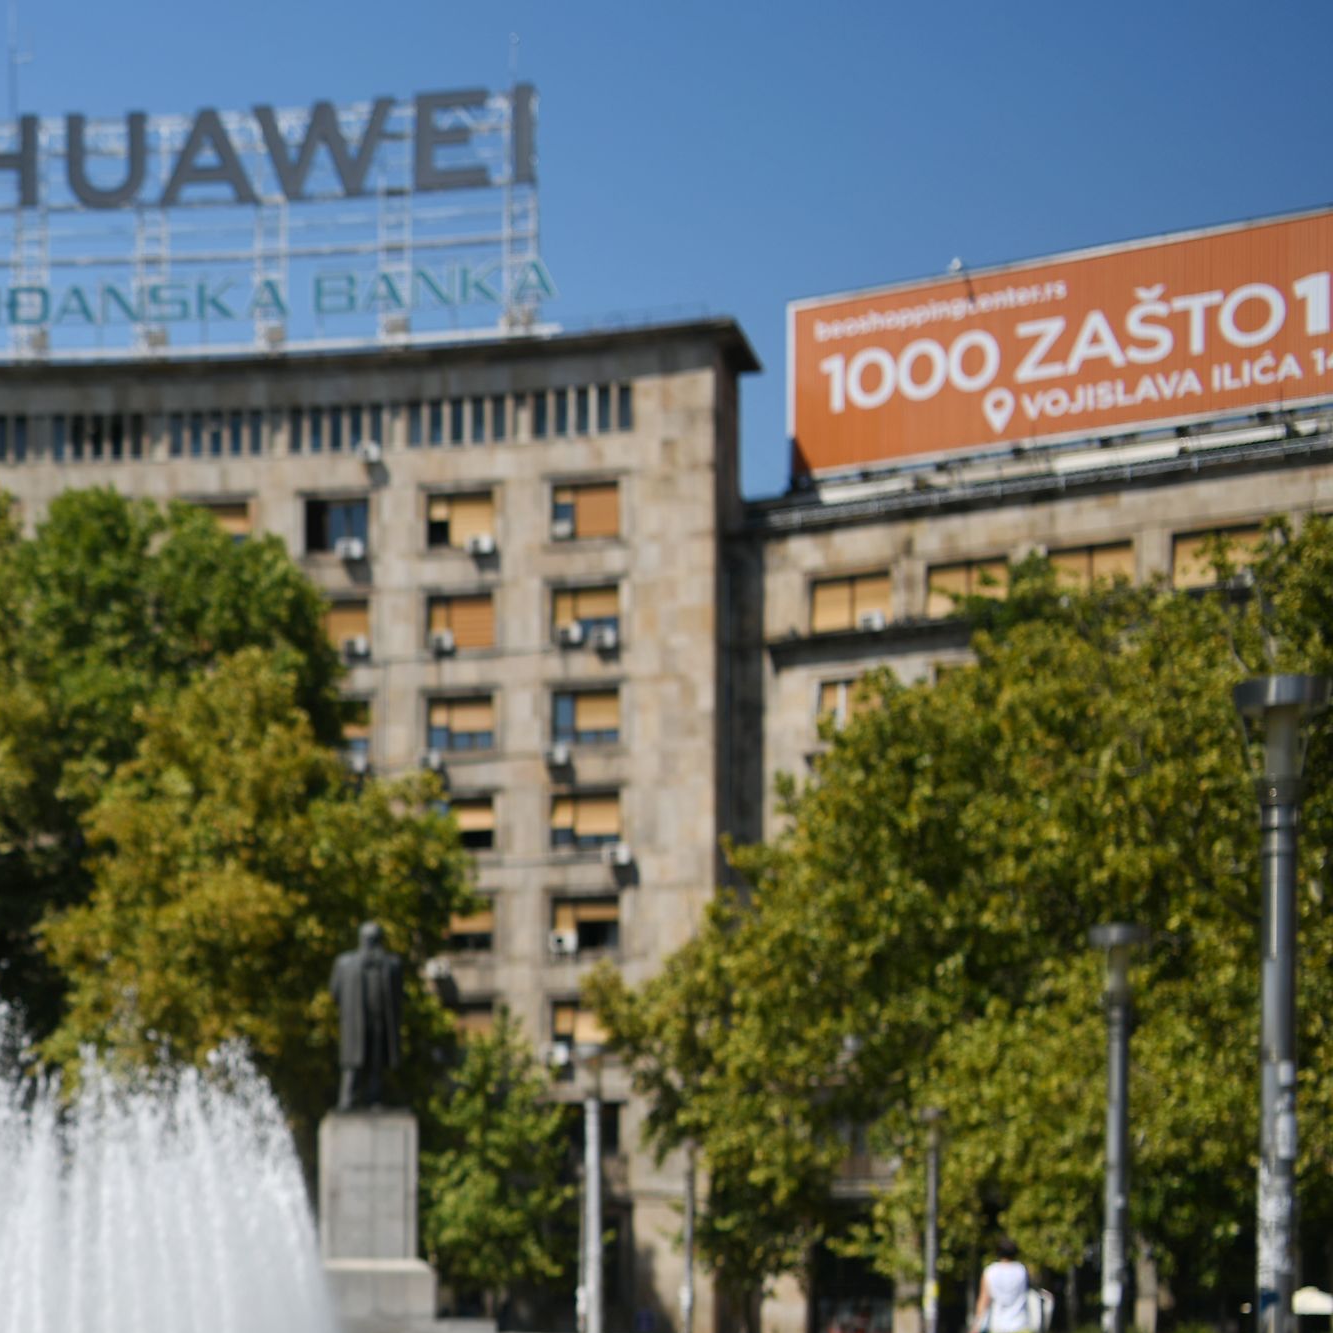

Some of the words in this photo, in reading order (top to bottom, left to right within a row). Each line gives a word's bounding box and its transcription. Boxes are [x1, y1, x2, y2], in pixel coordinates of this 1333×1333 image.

[313, 258, 558, 315] BANKA
[819, 327, 1002, 415] 1000
[1013, 282, 1287, 384] ZAŠTO
[1020, 366, 1203, 421] VOJISLAVA
[1211, 349, 1304, 392] ILIĆA
